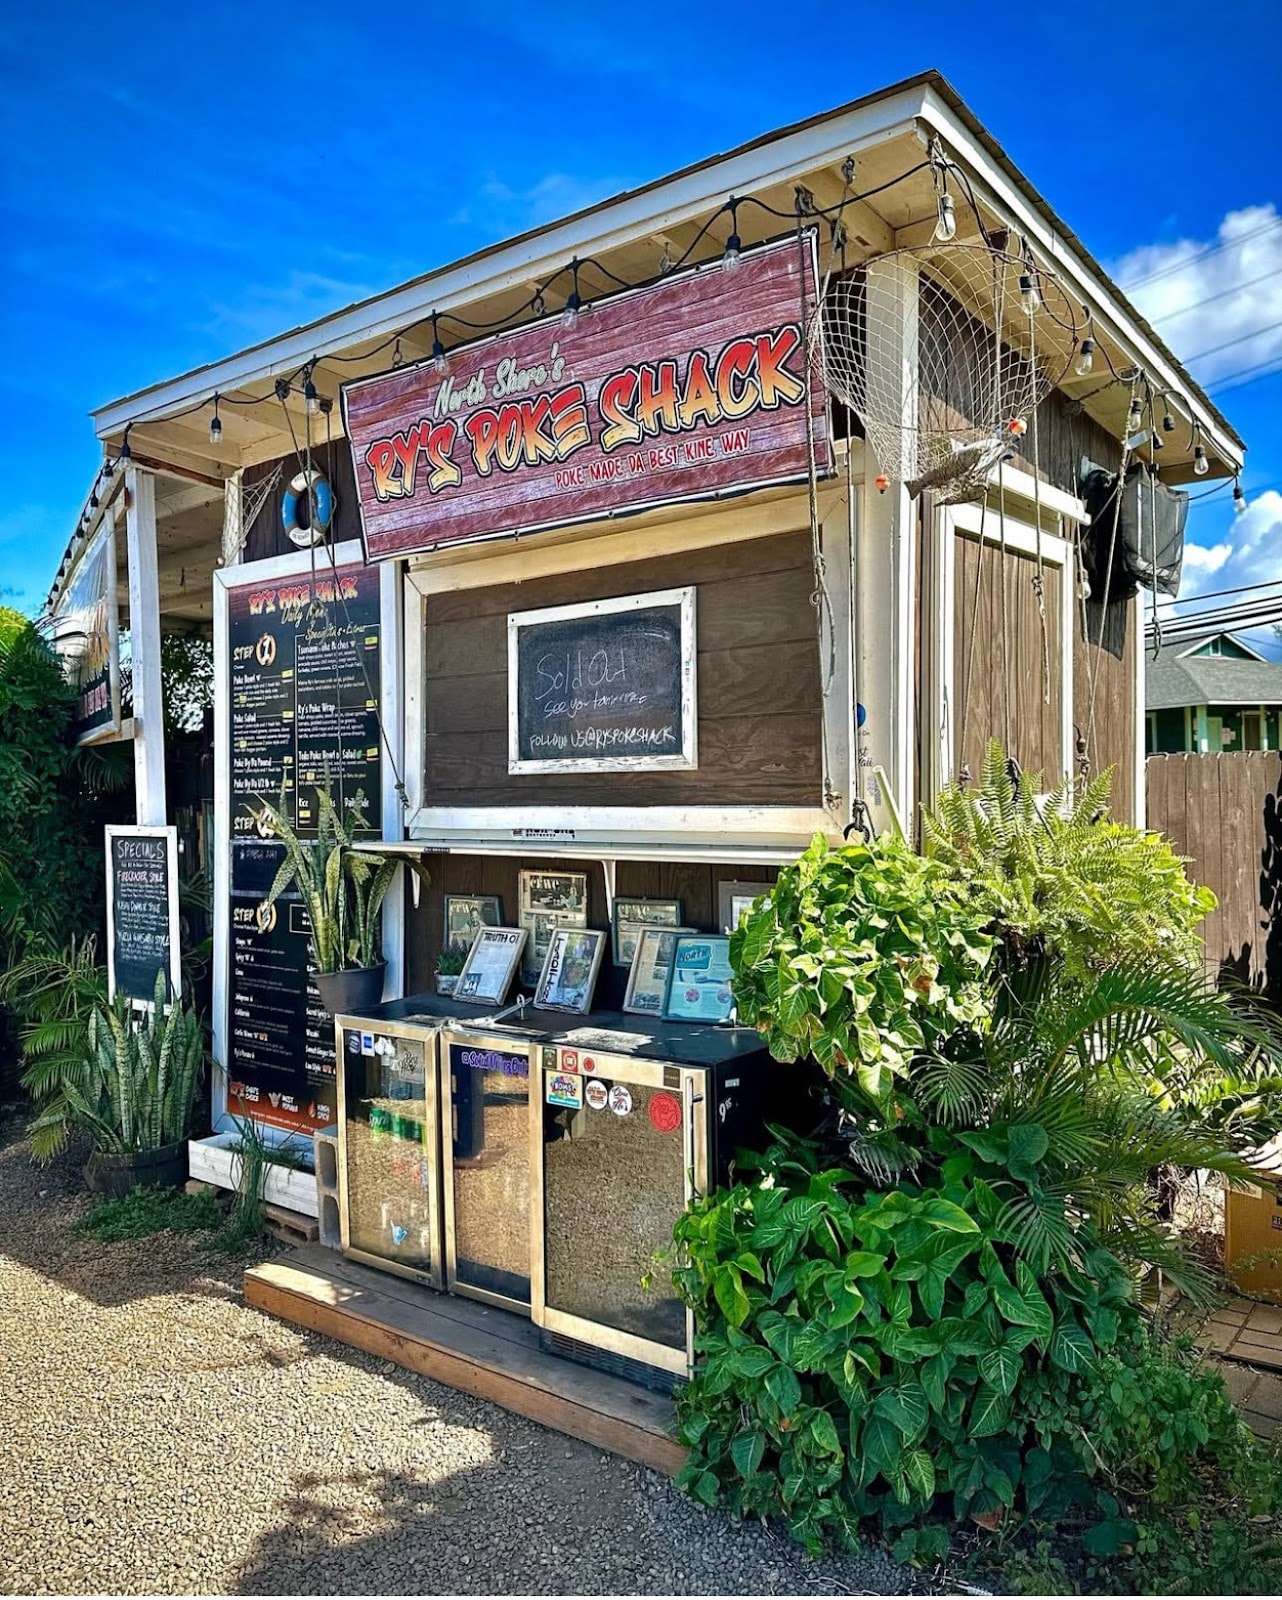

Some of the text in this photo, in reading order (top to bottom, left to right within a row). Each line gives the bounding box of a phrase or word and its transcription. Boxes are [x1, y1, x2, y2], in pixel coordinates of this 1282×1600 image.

[434, 342, 566, 419] North Shore's
[366, 322, 806, 502] RY'S POKE SHACK
[556, 429, 751, 490] POKE MADE DA BEST KINE WAY
[248, 589, 276, 615] RY'S
[278, 584, 310, 610] POKE
[233, 645, 254, 661] STEP
[535, 650, 627, 700] Sold Out
[530, 734, 568, 751] FOLLOW
[233, 817, 254, 830] STEP
[117, 840, 164, 859] SPECIALS
[233, 908, 254, 922] STEP
[484, 932, 508, 944] TRUTH
